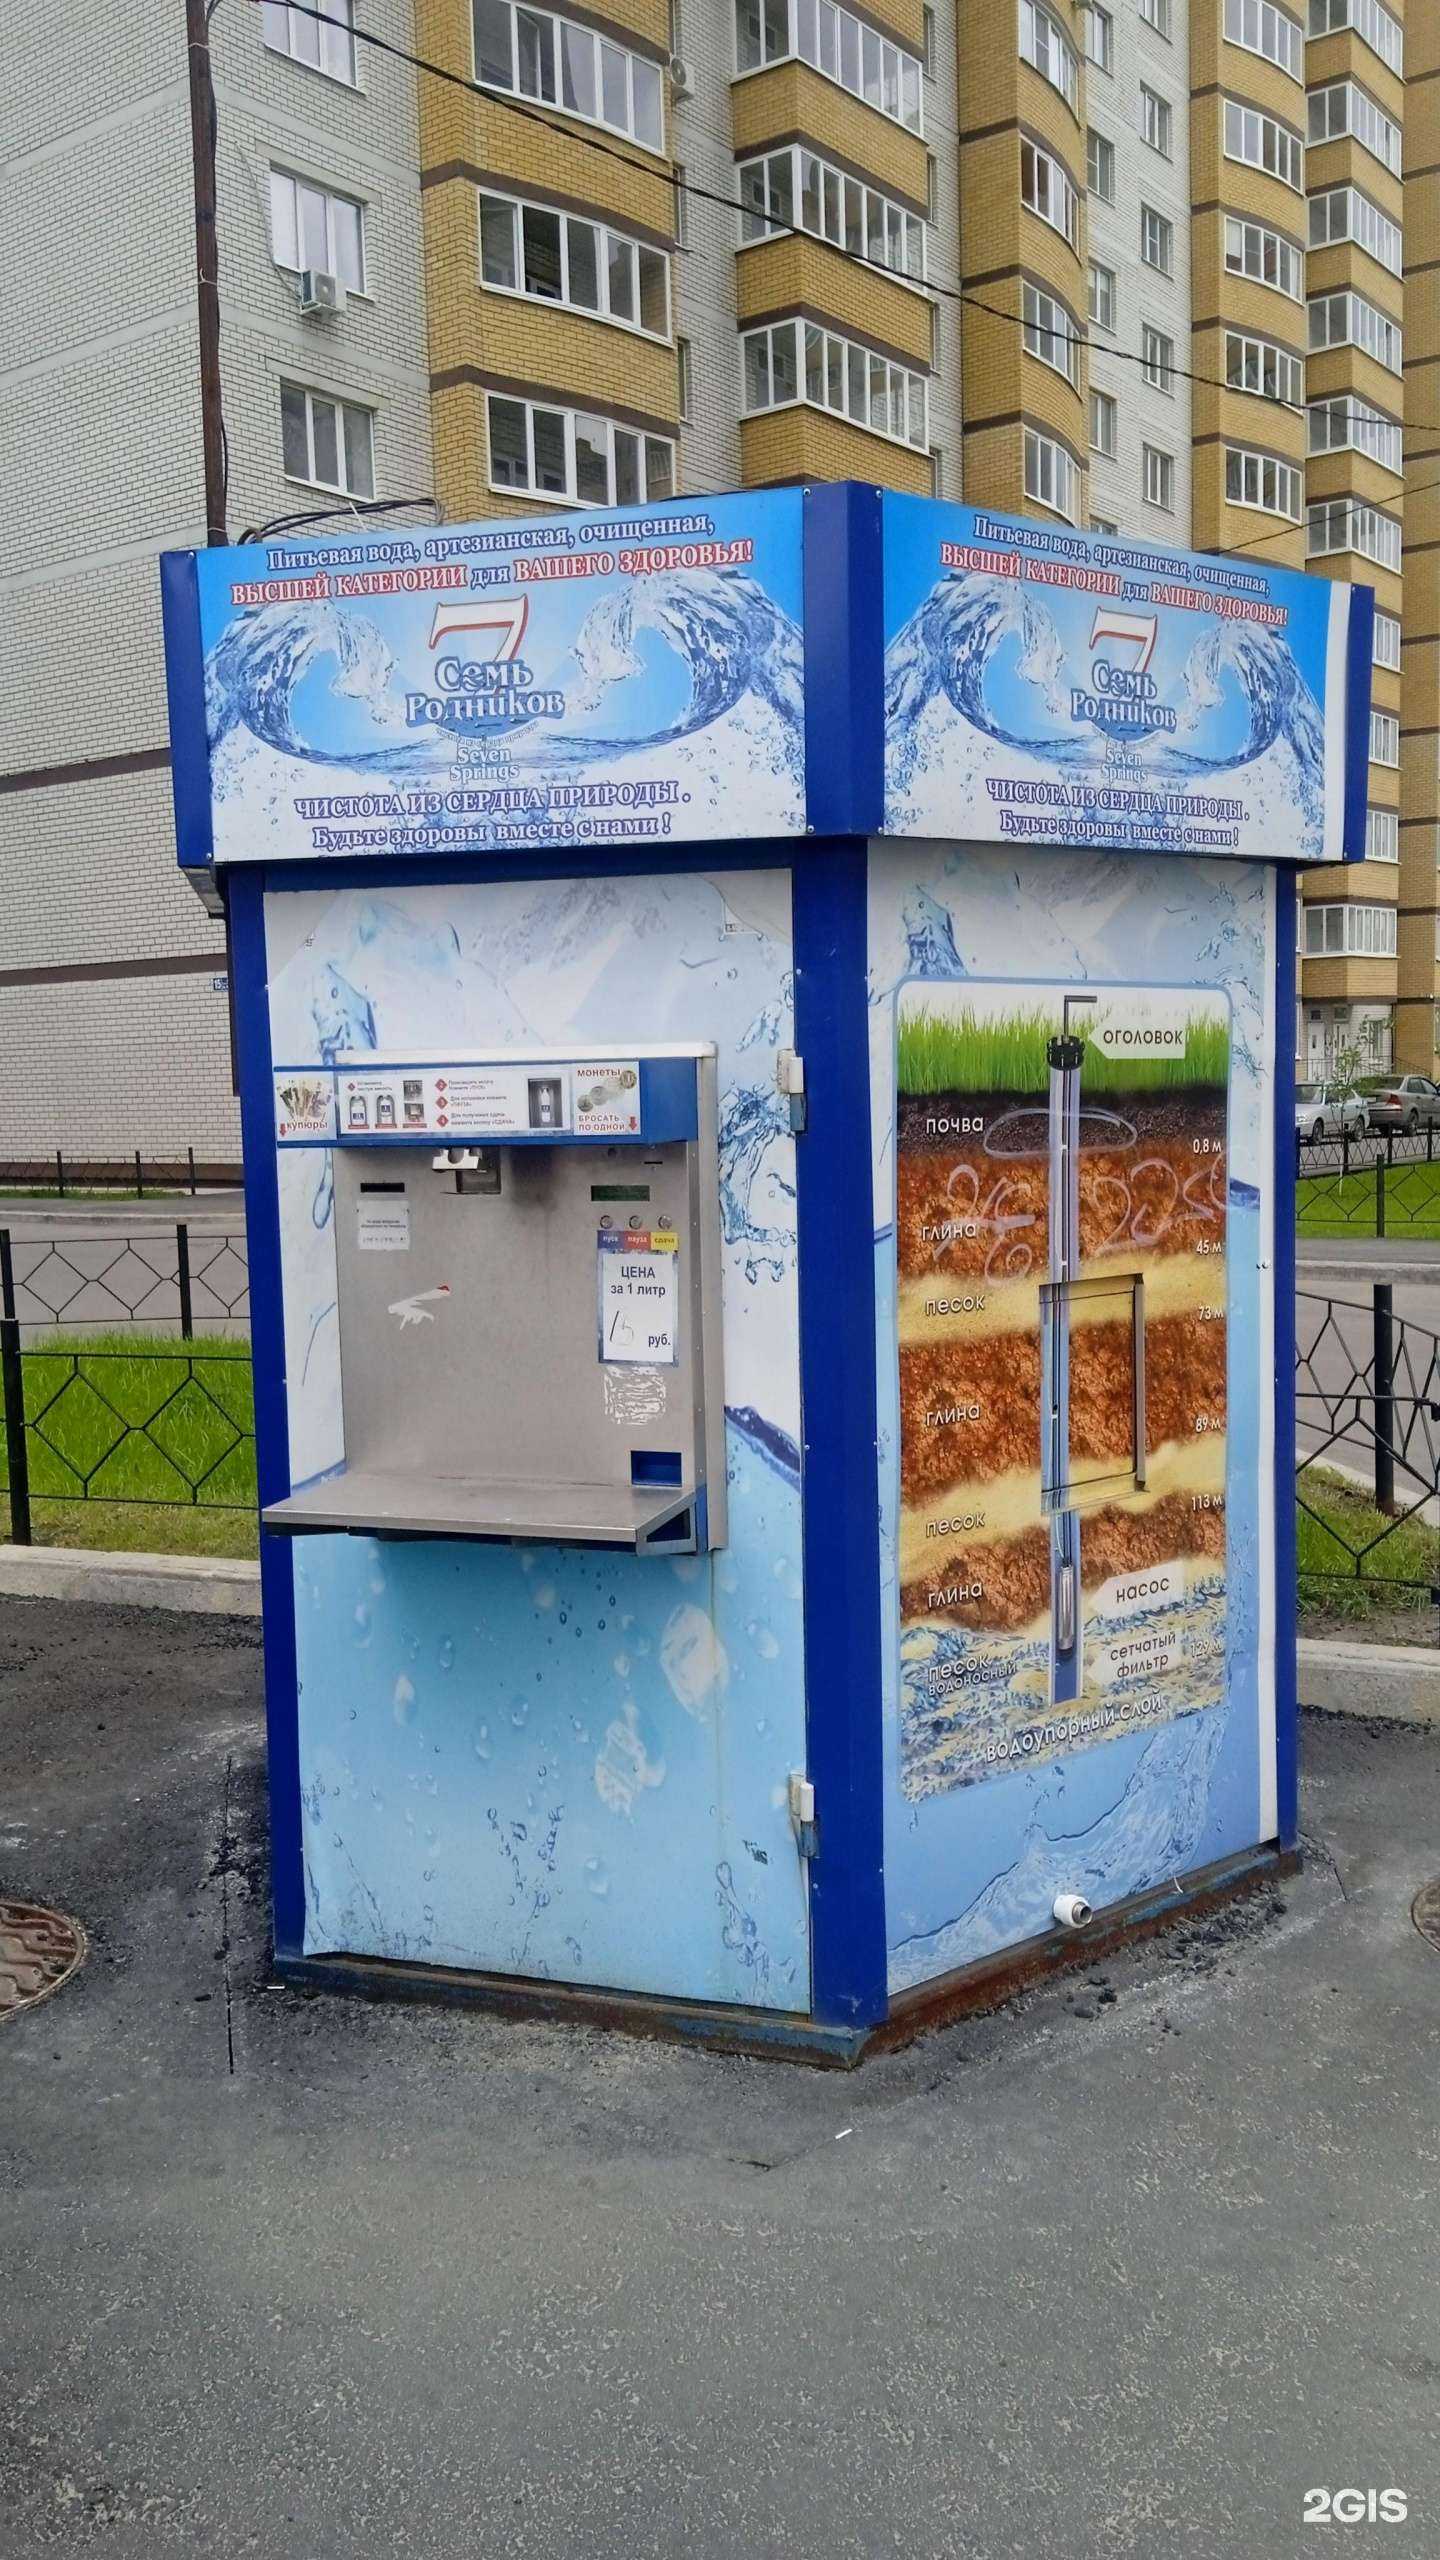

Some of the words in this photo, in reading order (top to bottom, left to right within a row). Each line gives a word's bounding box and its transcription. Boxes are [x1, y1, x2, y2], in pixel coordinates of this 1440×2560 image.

[266, 546, 363, 571] Питьевая
[367, 541, 421, 563] вода,
[425, 527, 575, 561] артезианская,
[580, 514, 715, 542] очищенная,
[973, 515, 1049, 550] Питьевая
[1052, 536, 1091, 562] вода,
[1094, 544, 1191, 583] артезианская,
[1194, 565, 1271, 598] очищенная,
[232, 573, 331, 605] ВЫСШЕЙ
[336, 565, 468, 597] КАТЕГОРИИ
[471, 566, 510, 588] для
[514, 552, 615, 582] ВАШЕГО
[618, 539, 754, 574] ЗДОРОВЬЯ!
[941, 542, 1022, 578] ВЫСШЕЙ
[1025, 559, 1121, 595] КАТЕГОРИИ
[1122, 582, 1149, 602] для
[1150, 582, 1213, 612] ВАШЕГО
[1215, 594, 1289, 626] ЗДОРОВЬЯ!
[428, 593, 529, 695] 7
[1089, 606, 1158, 702] 7
[435, 656, 534, 692] Семь
[1092, 659, 1158, 700] Семь
[405, 689, 566, 727] Родников
[1070, 688, 1177, 734] Родников
[456, 747, 512, 764] Seven
[1106, 749, 1143, 767] Seven
[450, 764, 520, 785] Springs
[1102, 763, 1147, 784] Springs
[294, 794, 406, 819] ЧИСТОТА
[408, 793, 442, 815] ИЗ
[446, 788, 544, 814] СЕРДЦА
[986, 779, 1070, 806] ЧИСТОТА
[1072, 786, 1097, 808] ИЗ
[1098, 788, 1163, 816] СЕРДЦА
[313, 827, 388, 852] Будьте
[389, 825, 487, 848] здоровы
[495, 820, 574, 841] вместе
[576, 821, 593, 838] с
[1000, 810, 1057, 836] Будьте
[1059, 819, 1126, 841] здоровы
[1131, 824, 1182, 842] вместе
[1183, 828, 1195, 843] с
[287, 1120, 328, 1131] купюры
[578, 1114, 620, 1122] БРОСАТЬ
[578, 1123, 591, 1131] ПО
[1192, 1138, 1210, 1154] 0,8
[1211, 1141, 1222, 1153] м
[1196, 1239, 1211, 1255] 45
[1212, 1243, 1223, 1254] м
[621, 1266, 656, 1279] ЦЕНА
[610, 1284, 623, 1294] за
[627, 1283, 632, 1295] 1
[637, 1285, 666, 1298] литр
[1198, 1306, 1213, 1321] 73
[1213, 1308, 1224, 1320] м
[648, 1333, 671, 1348] руб.
[1195, 1418, 1209, 1433] 89
[1209, 1417, 1221, 1430] м
[1190, 1495, 1210, 1511] 113
[1211, 1495, 1223, 1507] м
[1110, 1630, 1176, 1661] сетчатый
[1116, 1653, 1169, 1679] фильтр
[985, 1702, 1117, 1764] водоупорный
[1119, 1687, 1165, 1722] слой
